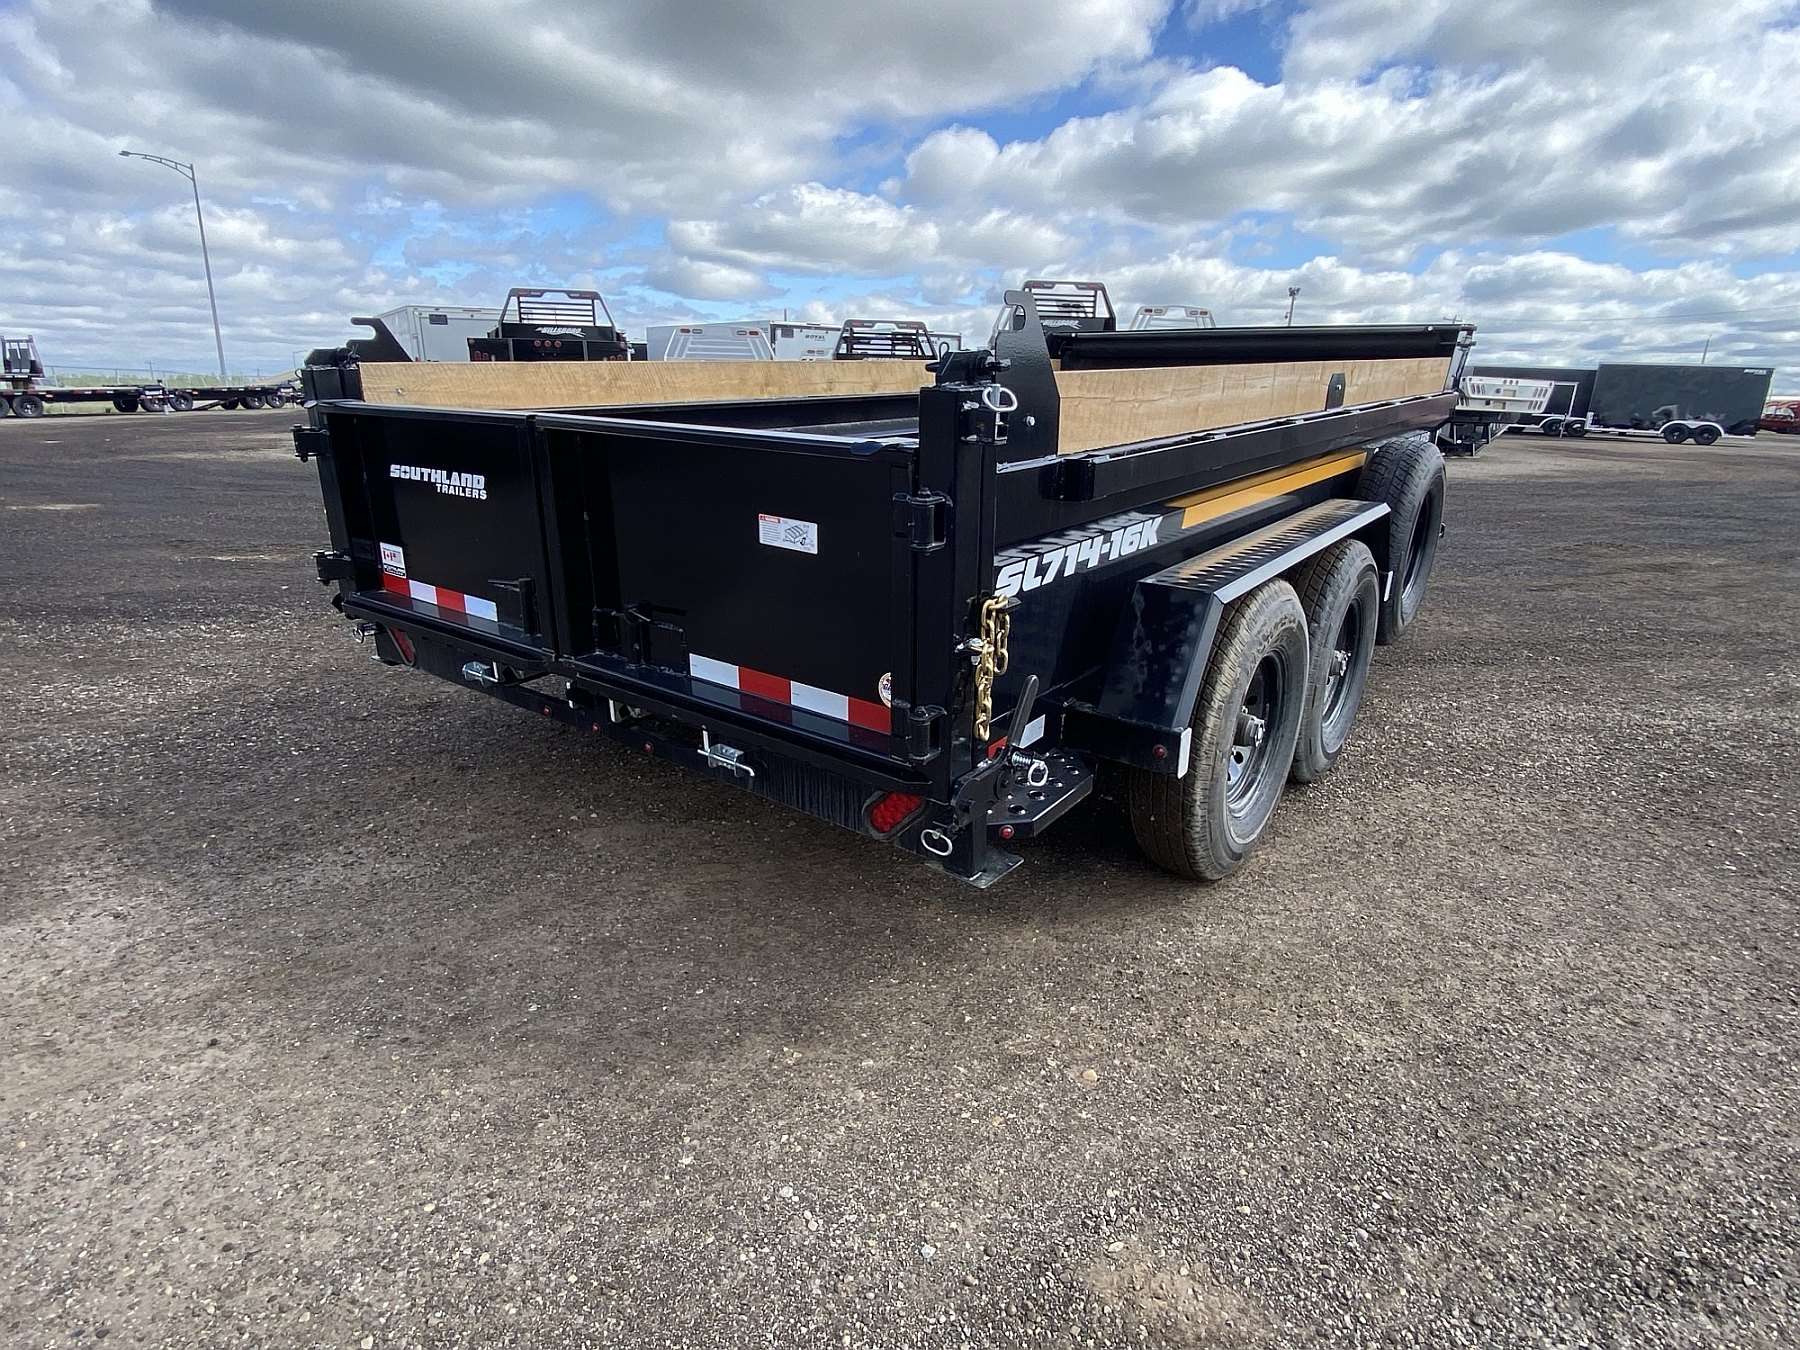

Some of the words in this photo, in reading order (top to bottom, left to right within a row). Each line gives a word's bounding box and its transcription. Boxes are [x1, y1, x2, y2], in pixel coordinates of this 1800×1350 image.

[390, 464, 485, 489] SOUTHLAND
[436, 483, 487, 500] TRAILERS
[994, 516, 1163, 598] SL714-16K
